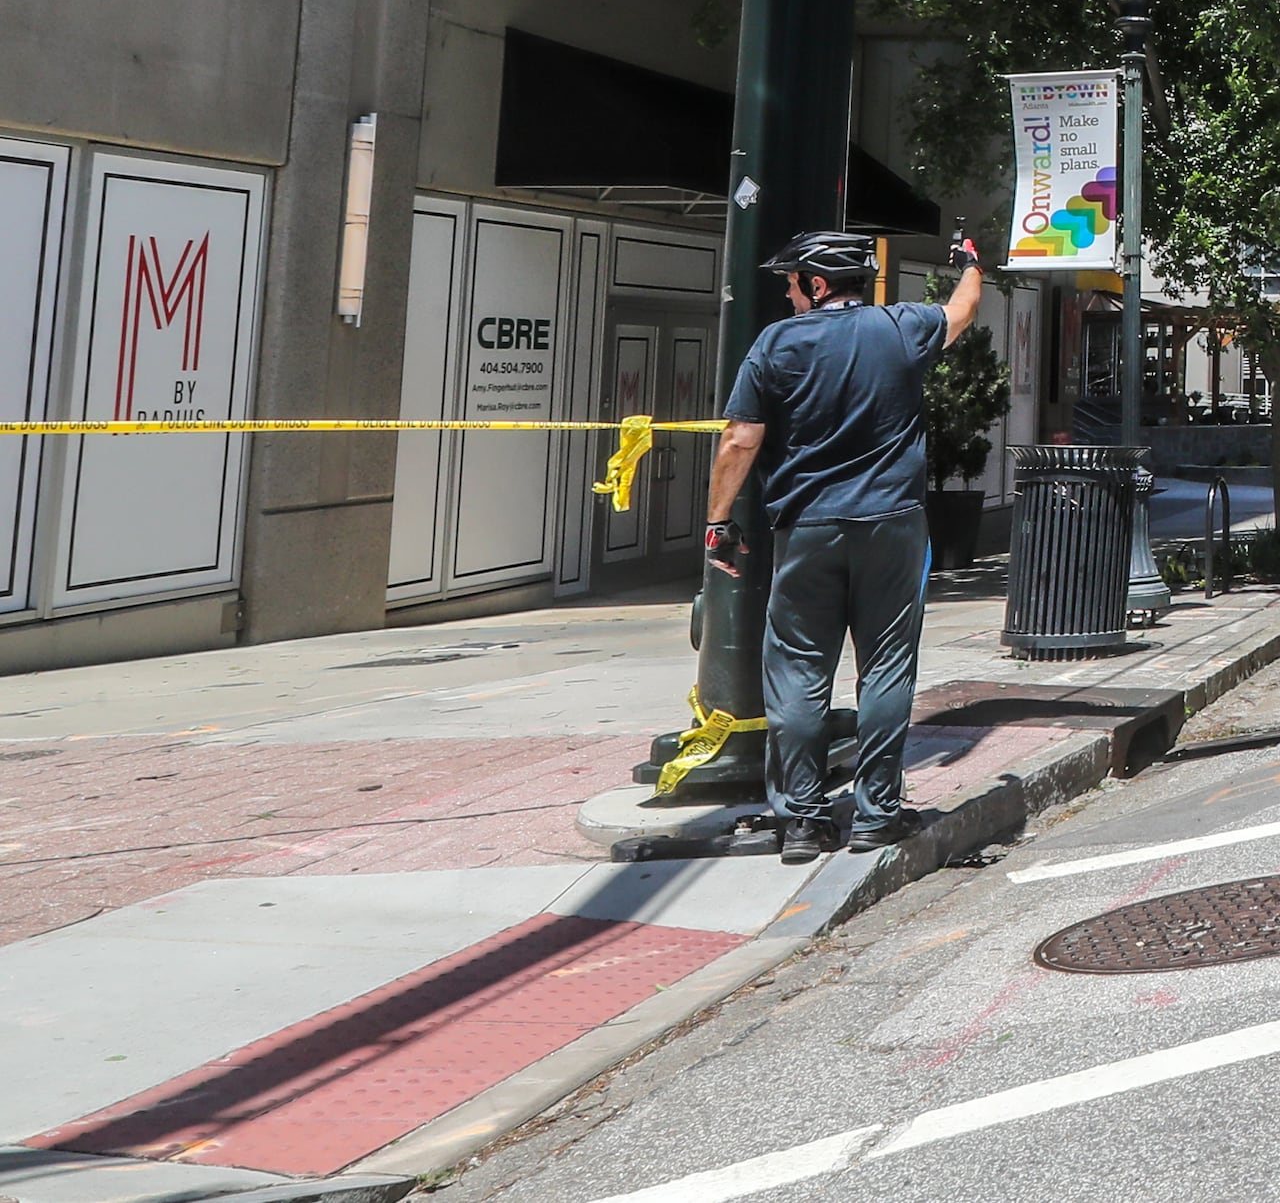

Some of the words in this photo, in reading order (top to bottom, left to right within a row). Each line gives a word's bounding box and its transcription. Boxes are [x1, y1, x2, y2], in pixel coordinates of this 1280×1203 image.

[1020, 83, 1108, 101] MIDTOWN
[1022, 102, 1049, 111] Atlanta
[1059, 114, 1099, 128] Make
[1060, 132, 1078, 142] no
[1060, 143, 1097, 157] small
[1060, 158, 1100, 174] plans.
[1022, 116, 1052, 235] Onward!
[477, 316, 551, 350] CBRE
[479, 362, 544, 374] 404.504.7900
[173, 381, 197, 405] BY
